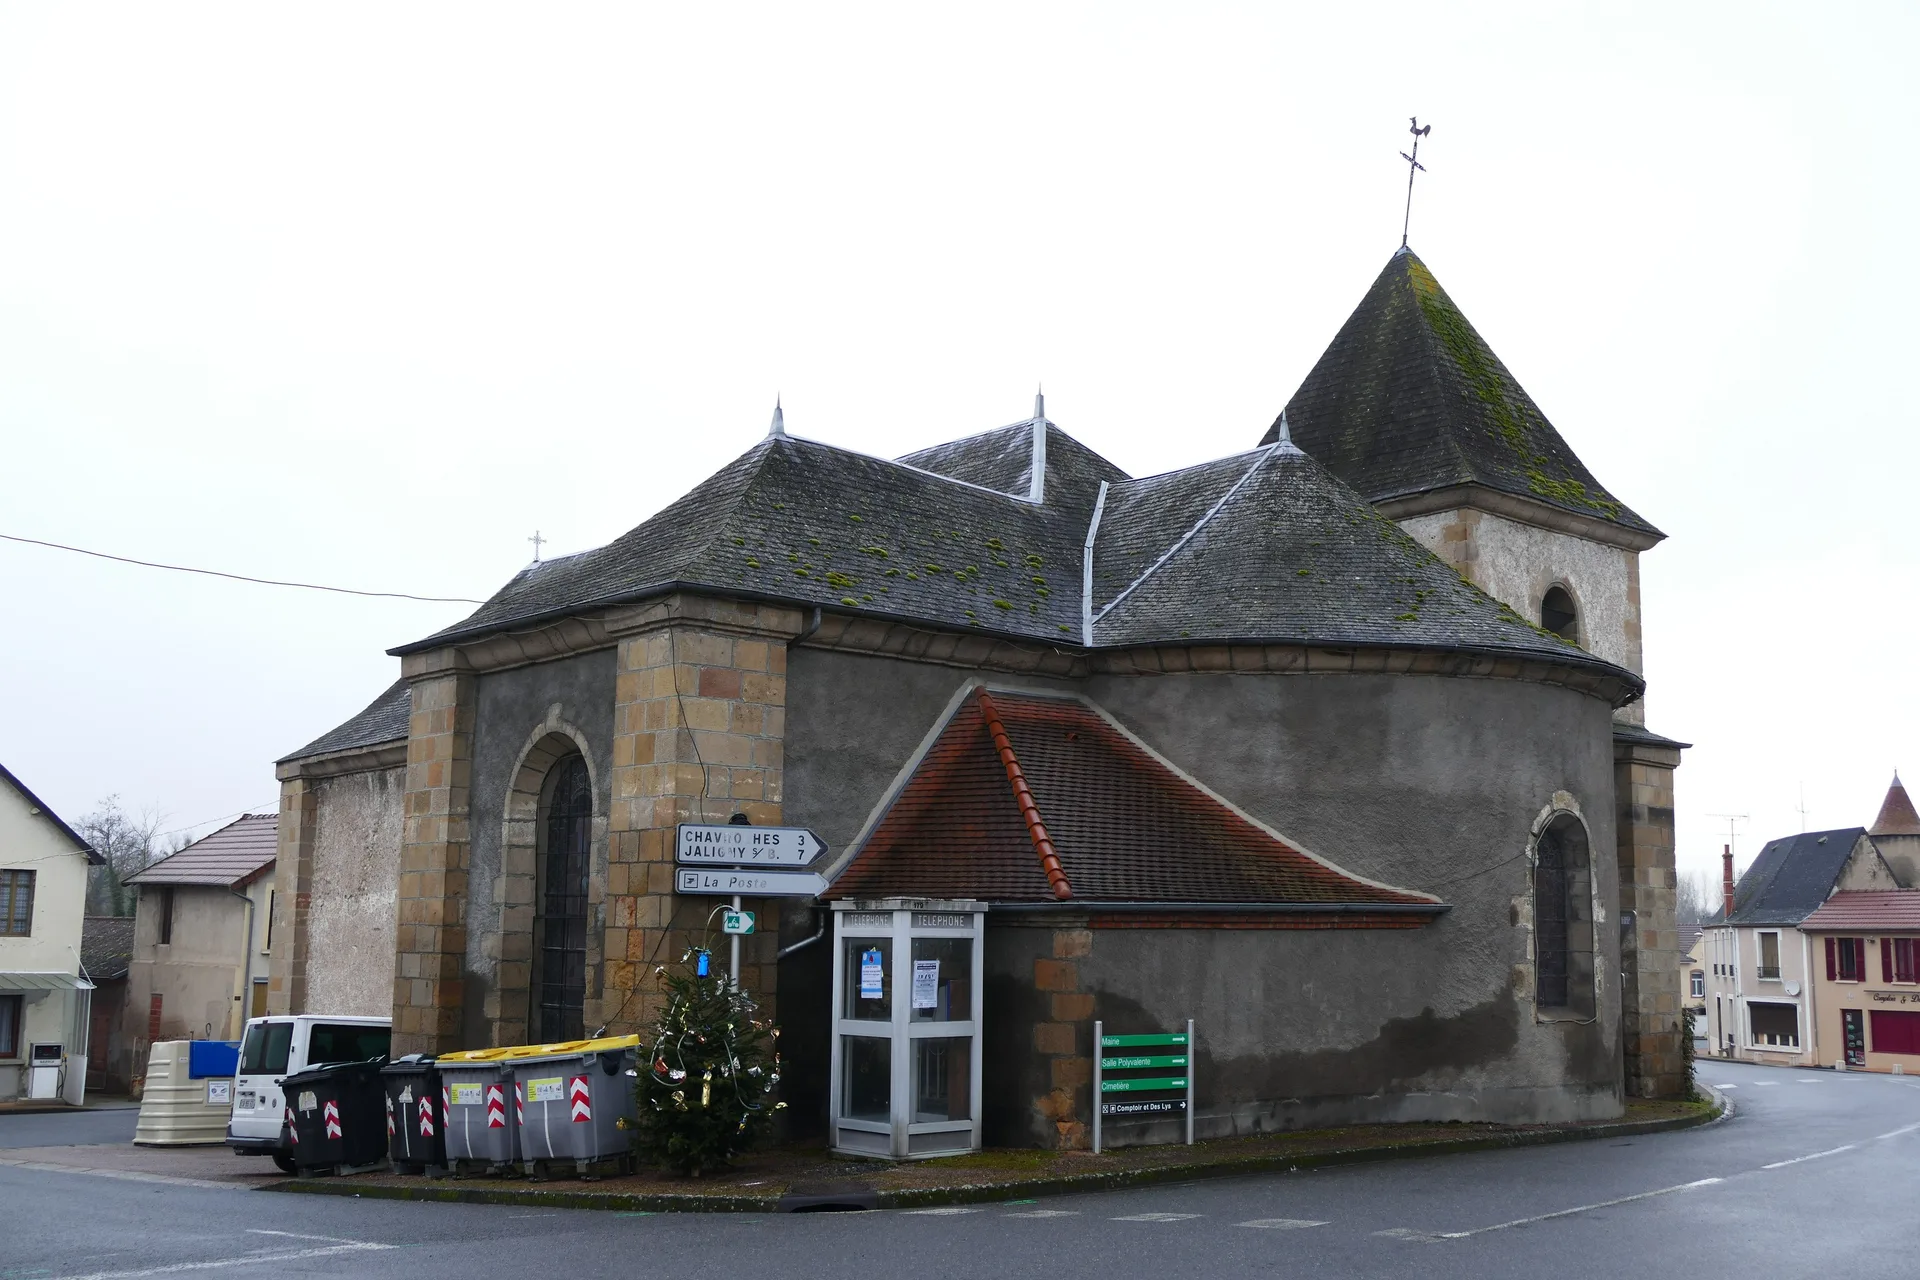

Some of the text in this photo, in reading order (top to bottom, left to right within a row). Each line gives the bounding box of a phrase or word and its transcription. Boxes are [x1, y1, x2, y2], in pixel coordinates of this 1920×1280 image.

[685, 830, 805, 846] CHAVROHES 3
[797, 849, 805, 860] 7
[703, 876, 768, 889] La Poste
[850, 914, 889, 926] TELEPHONE
[917, 915, 965, 927] TELEPHONE
[1101, 1037, 1120, 1046] Mairie
[1101, 1057, 1151, 1068] Salle Polyvalente
[1101, 1081, 1130, 1091] Cimetière
[1116, 1102, 1172, 1113] Comptoir et Des Lys
